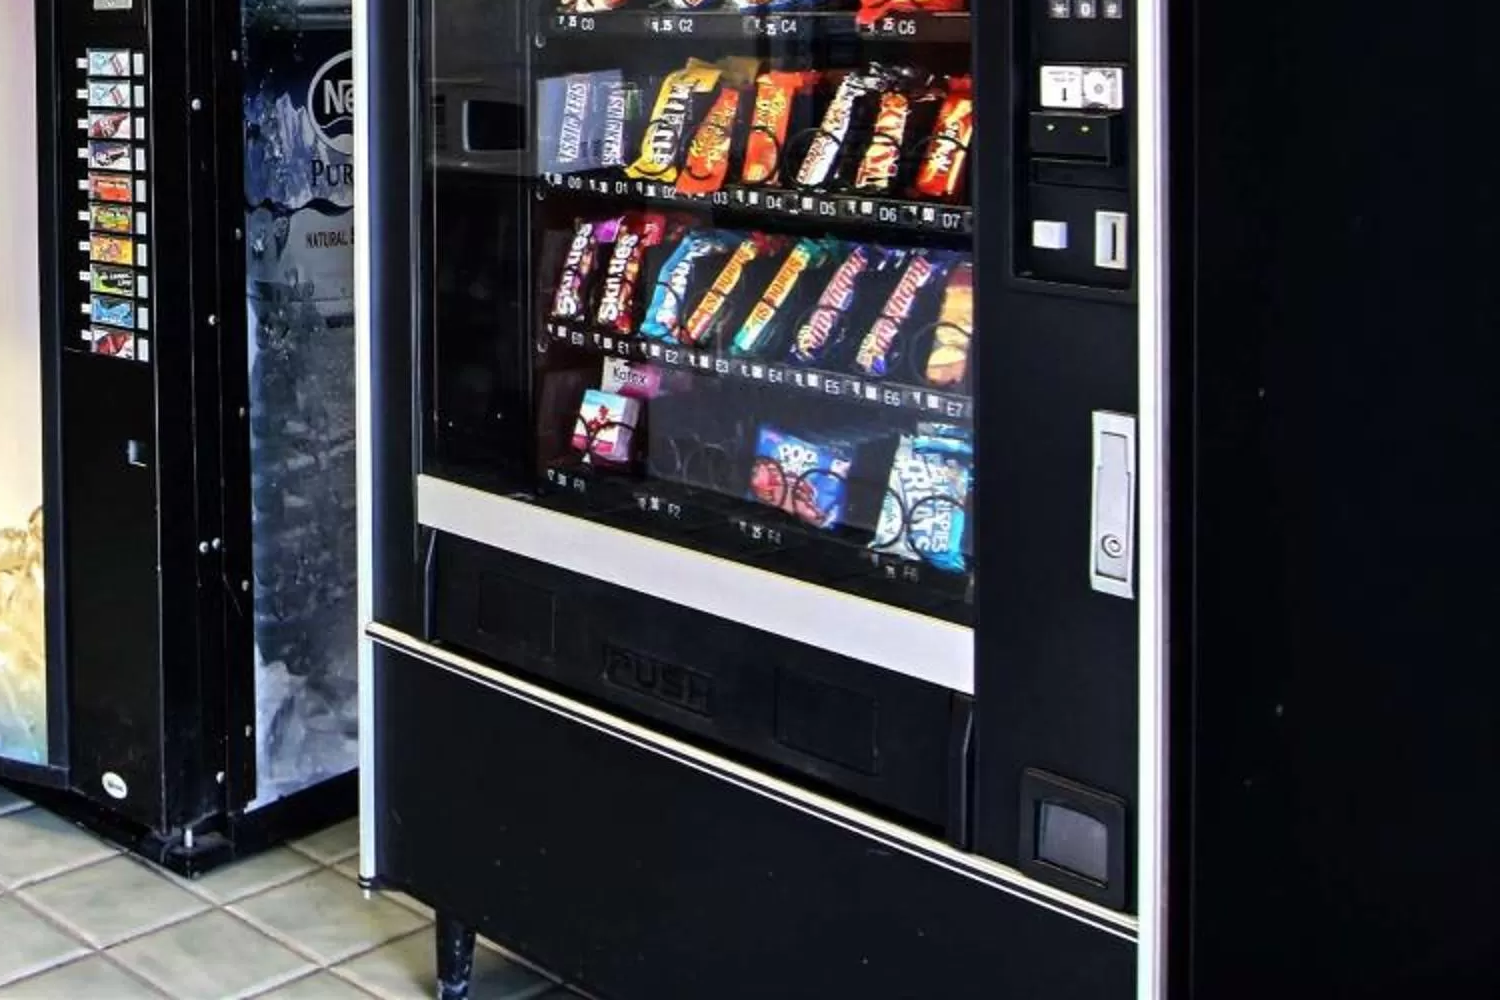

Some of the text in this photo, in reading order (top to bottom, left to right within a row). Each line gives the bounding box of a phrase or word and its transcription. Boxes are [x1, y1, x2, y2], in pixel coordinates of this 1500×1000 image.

[678, 19, 693, 33] C2
[781, 18, 797, 34] C4
[898, 19, 916, 35] C6
[820, 201, 836, 216] D5
[880, 207, 896, 222] D6
[943, 213, 961, 229] D7
[306, 231, 348, 249] NATURAL
[665, 349, 679, 363] E2
[715, 359, 729, 373] E3
[768, 368, 782, 383] E4
[825, 379, 840, 395] E5
[883, 389, 900, 406] E6
[947, 401, 964, 418] E7
